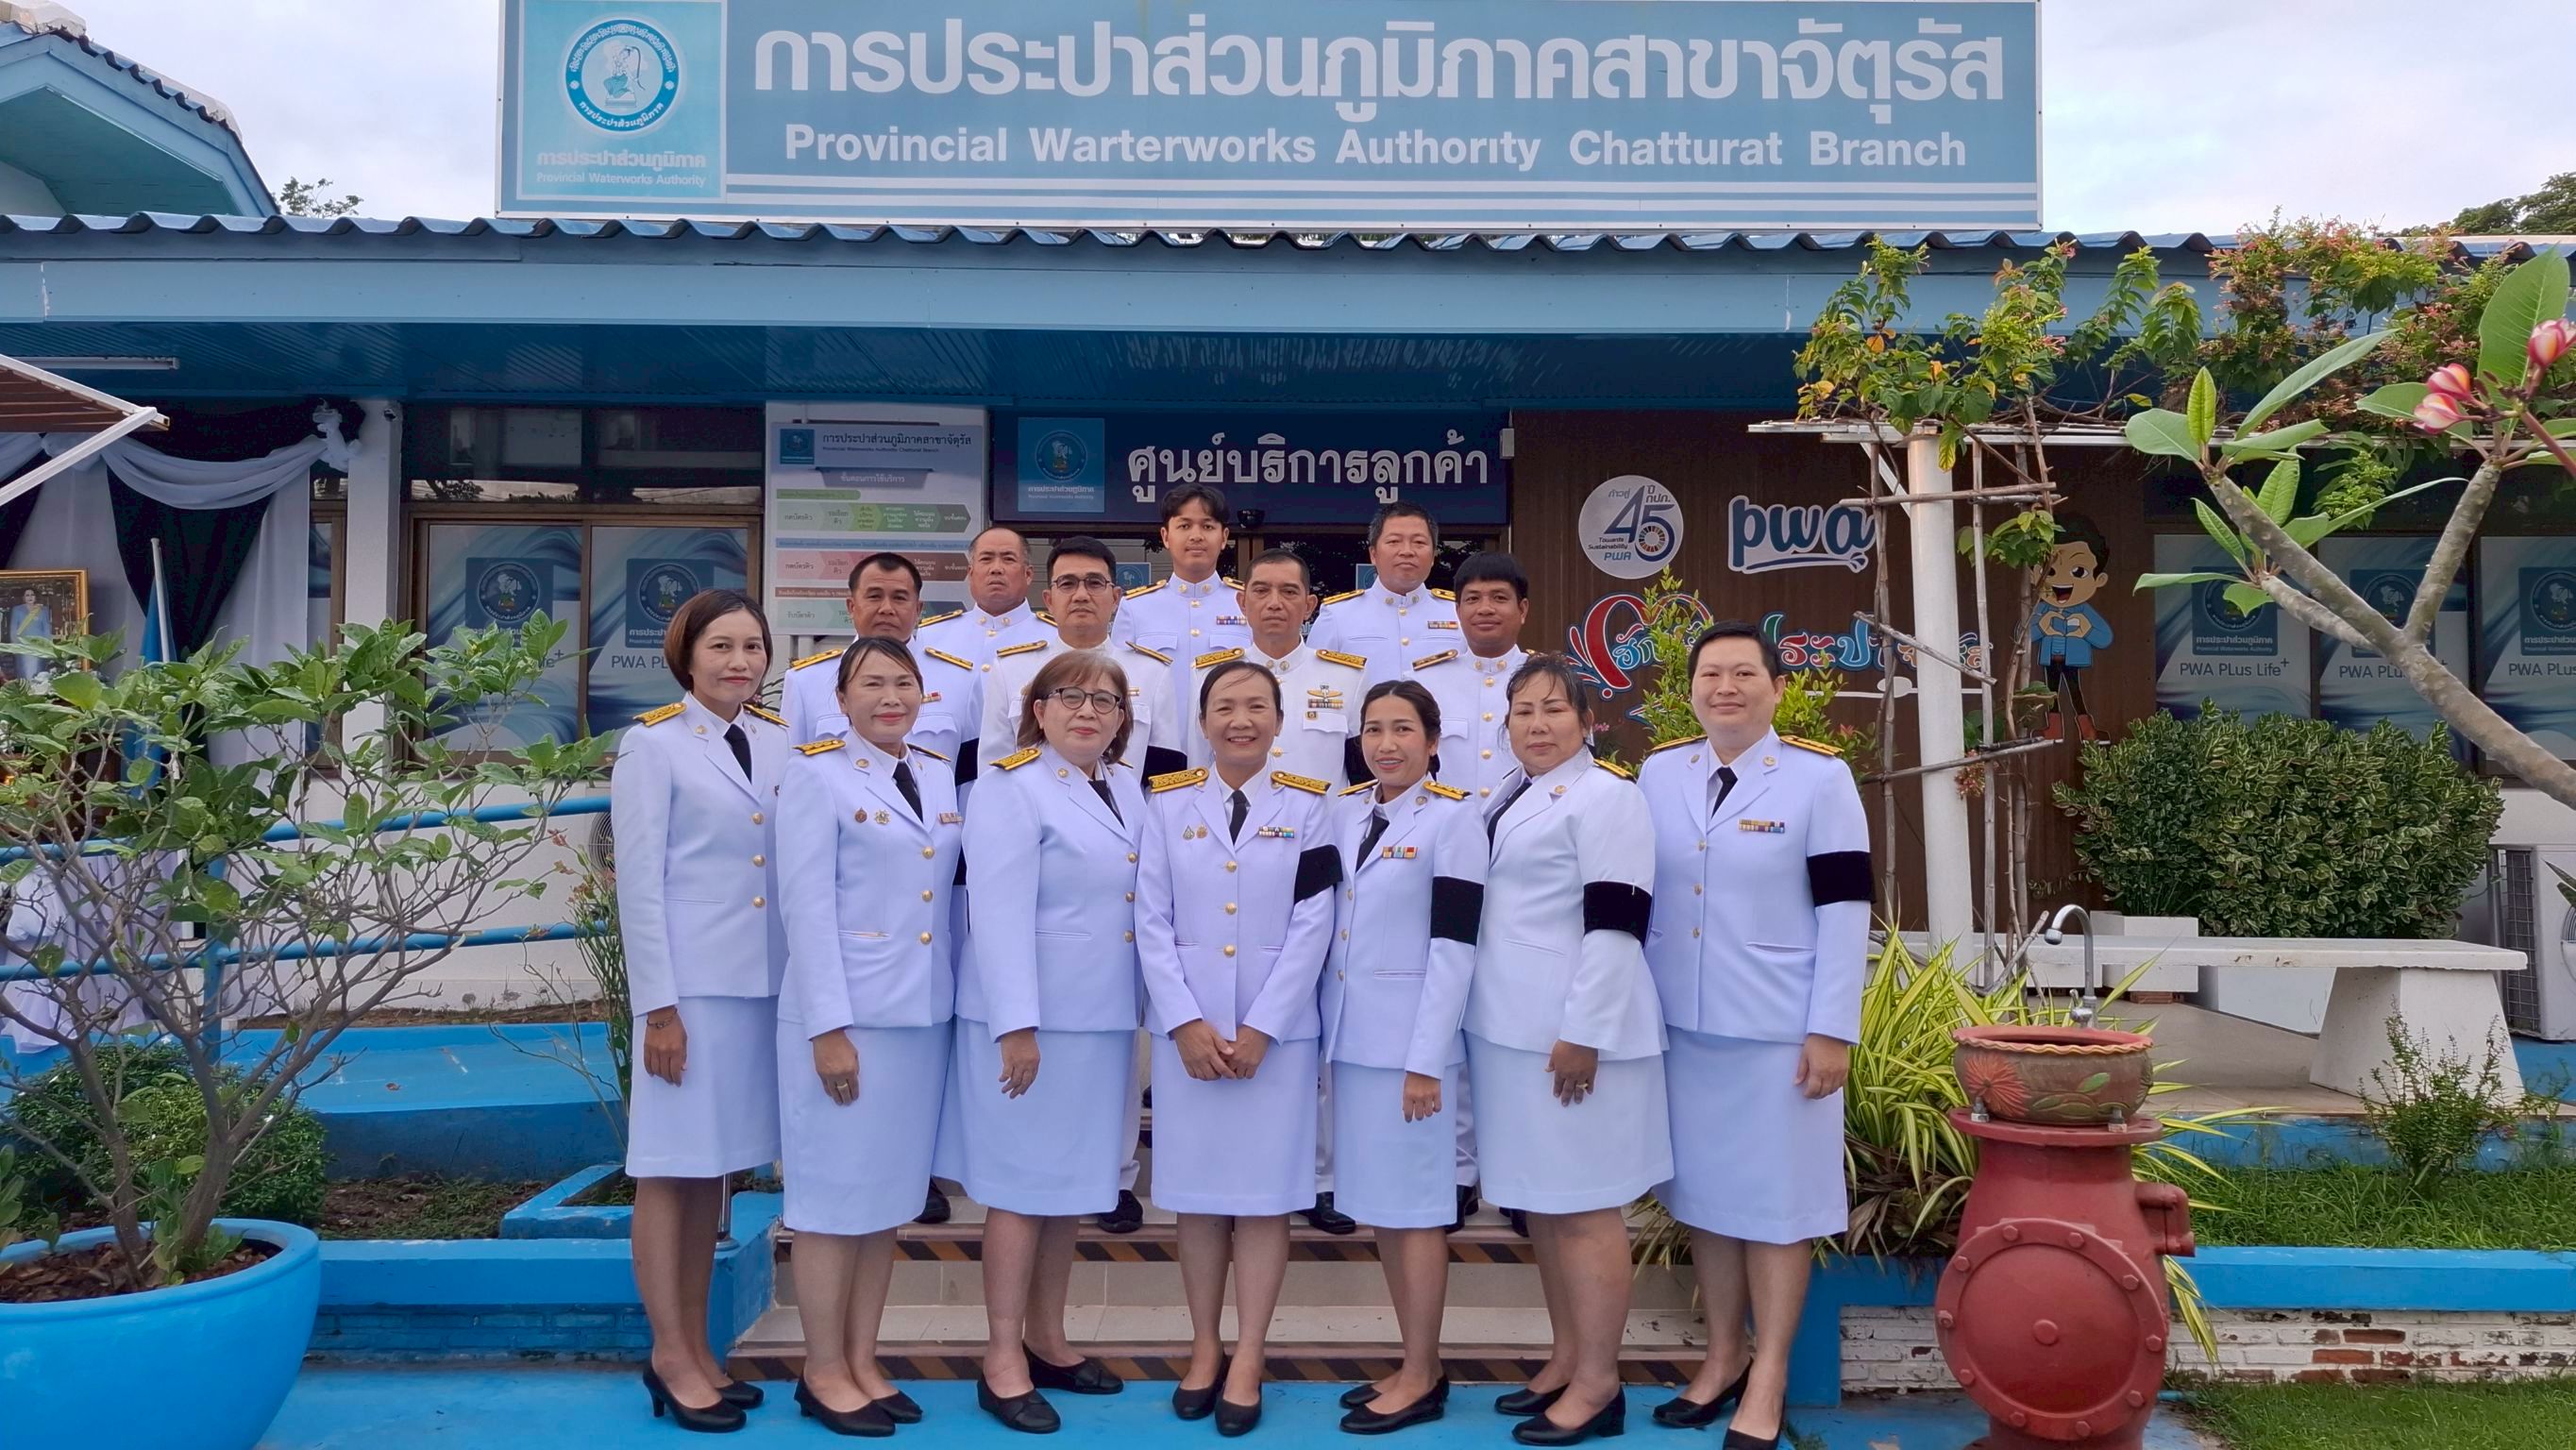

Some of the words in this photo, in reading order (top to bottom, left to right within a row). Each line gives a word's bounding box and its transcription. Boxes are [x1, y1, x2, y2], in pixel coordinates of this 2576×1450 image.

[755, 14, 2003, 125] การประปาส่วนภูมิภาคสาขาจัตุรัส
[785, 124, 1007, 162] Provincial
[1029, 127, 1317, 163] Warterworks
[1336, 128, 1541, 172] Authority
[1569, 129, 1783, 167] Chatturat
[1810, 130, 1966, 167] Branch
[537, 149, 706, 172] การประปาส่วนภูมิภาค
[536, 172, 585, 183] Provincial
[589, 173, 652, 184] Waterworks
[656, 175, 706, 188] Authority
[1128, 429, 1488, 504] ศูนย์บริการลูกค้า
[1604, 485, 1675, 562] 45
[1732, 498, 1876, 567] pwa
[1604, 551, 1631, 561] PWA
[612, 655, 646, 668] PWA
[2180, 663, 2214, 676] PWA
[2508, 663, 2543, 676] PWA
[2339, 665, 2373, 678] PWA
[2379, 665, 2406, 678] PLu
